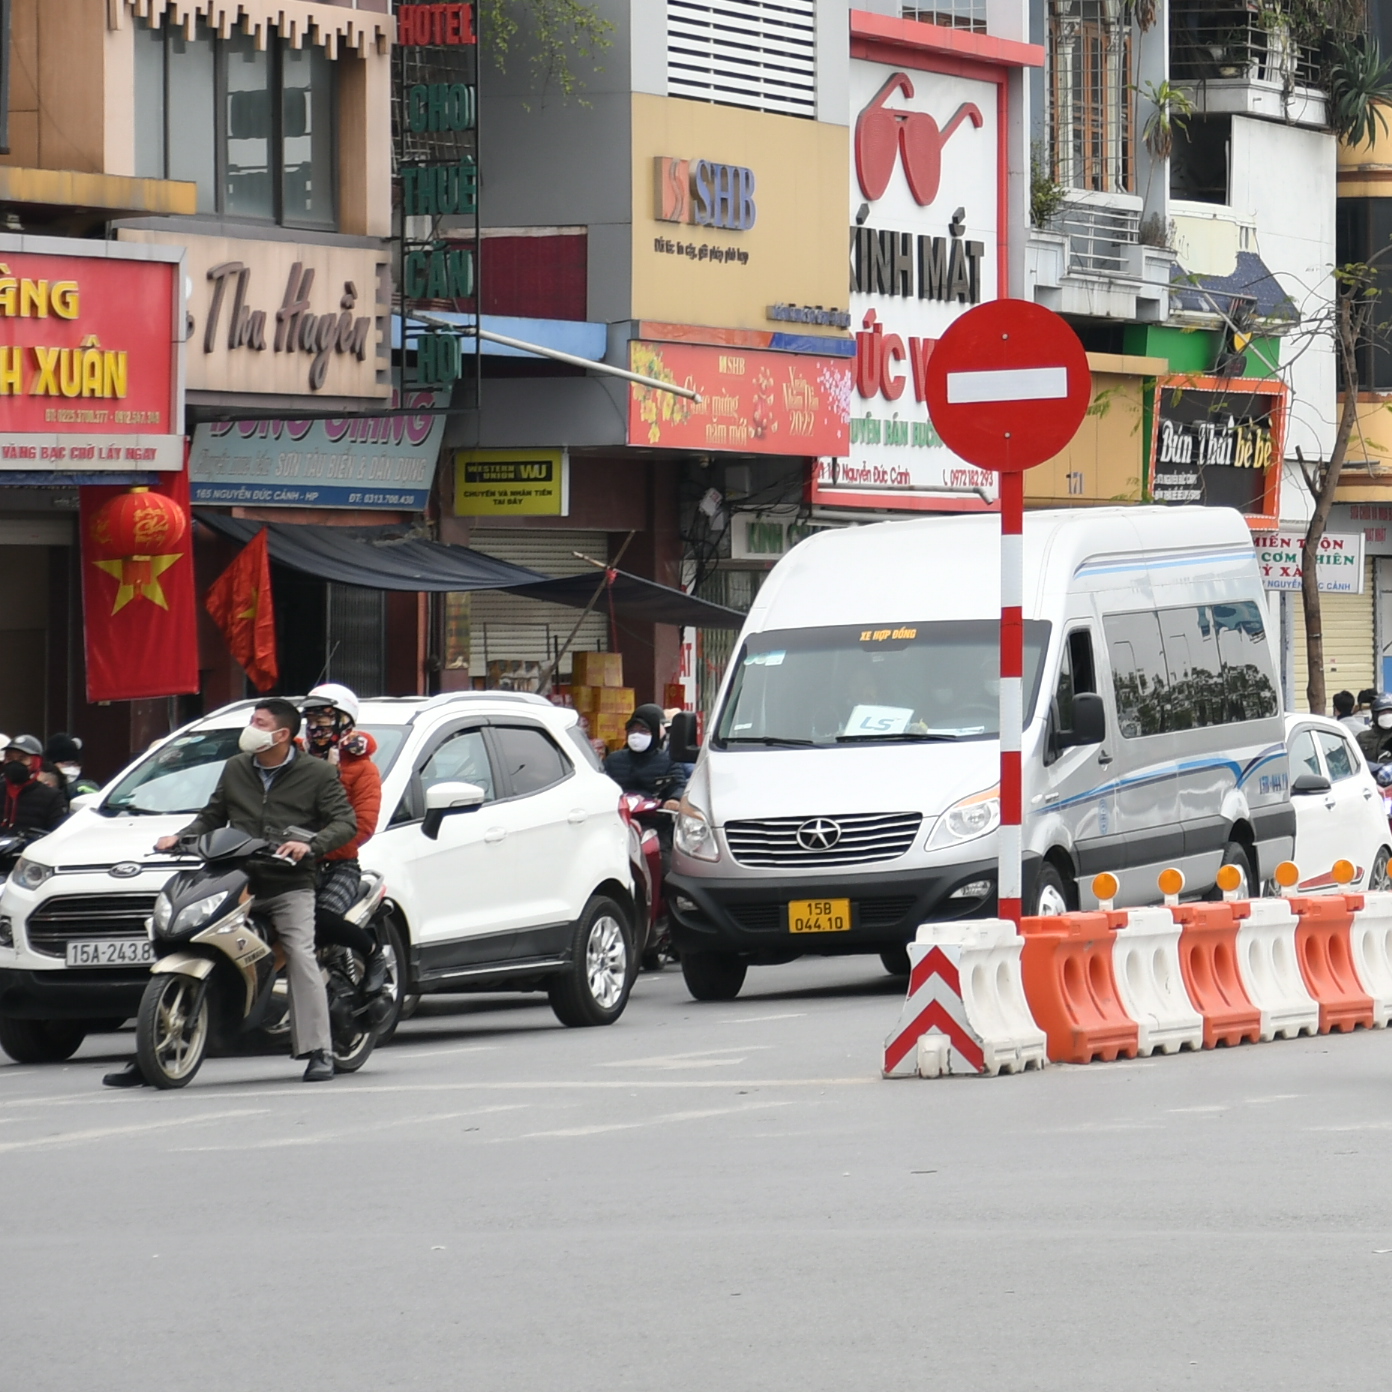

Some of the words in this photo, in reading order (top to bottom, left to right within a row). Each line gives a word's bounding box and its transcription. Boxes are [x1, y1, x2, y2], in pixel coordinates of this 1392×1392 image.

[398, 3, 477, 46] HOTEL
[410, 83, 475, 132] CHO
[401, 155, 477, 215] THUÊ
[693, 159, 758, 232] SHB
[204, 261, 267, 354] Thu
[273, 261, 371, 391] Huyền
[29, 334, 128, 399] XUÂN
[726, 357, 745, 376] SHB
[849, 308, 906, 401] ỨC
[706, 418, 727, 444] năm
[789, 410, 815, 437] 2022
[883, 411, 908, 446] BÁN
[1160, 420, 1193, 463] Bún
[41, 446, 66, 463] BẠC
[125, 447, 157, 461] NGAY
[467, 465, 515, 473] WESTERN
[519, 464, 548, 479] WU
[842, 460, 872, 483] Nguyễn
[873, 464, 888, 483] Đức
[889, 467, 910, 484] Cảnh
[1066, 471, 1084, 495] 171
[196, 488, 212, 499] 165
[213, 485, 252, 501] NGUYỄN
[252, 487, 272, 501] ĐỨC
[305, 492, 319, 502] HP
[1261, 551, 1297, 563] CƠM
[1327, 581, 1351, 590] CẢNH
[860, 630, 871, 641] XE
[872, 629, 891, 643] HỢP
[807, 902, 832, 916] 15B
[795, 916, 844, 931] 044.10
